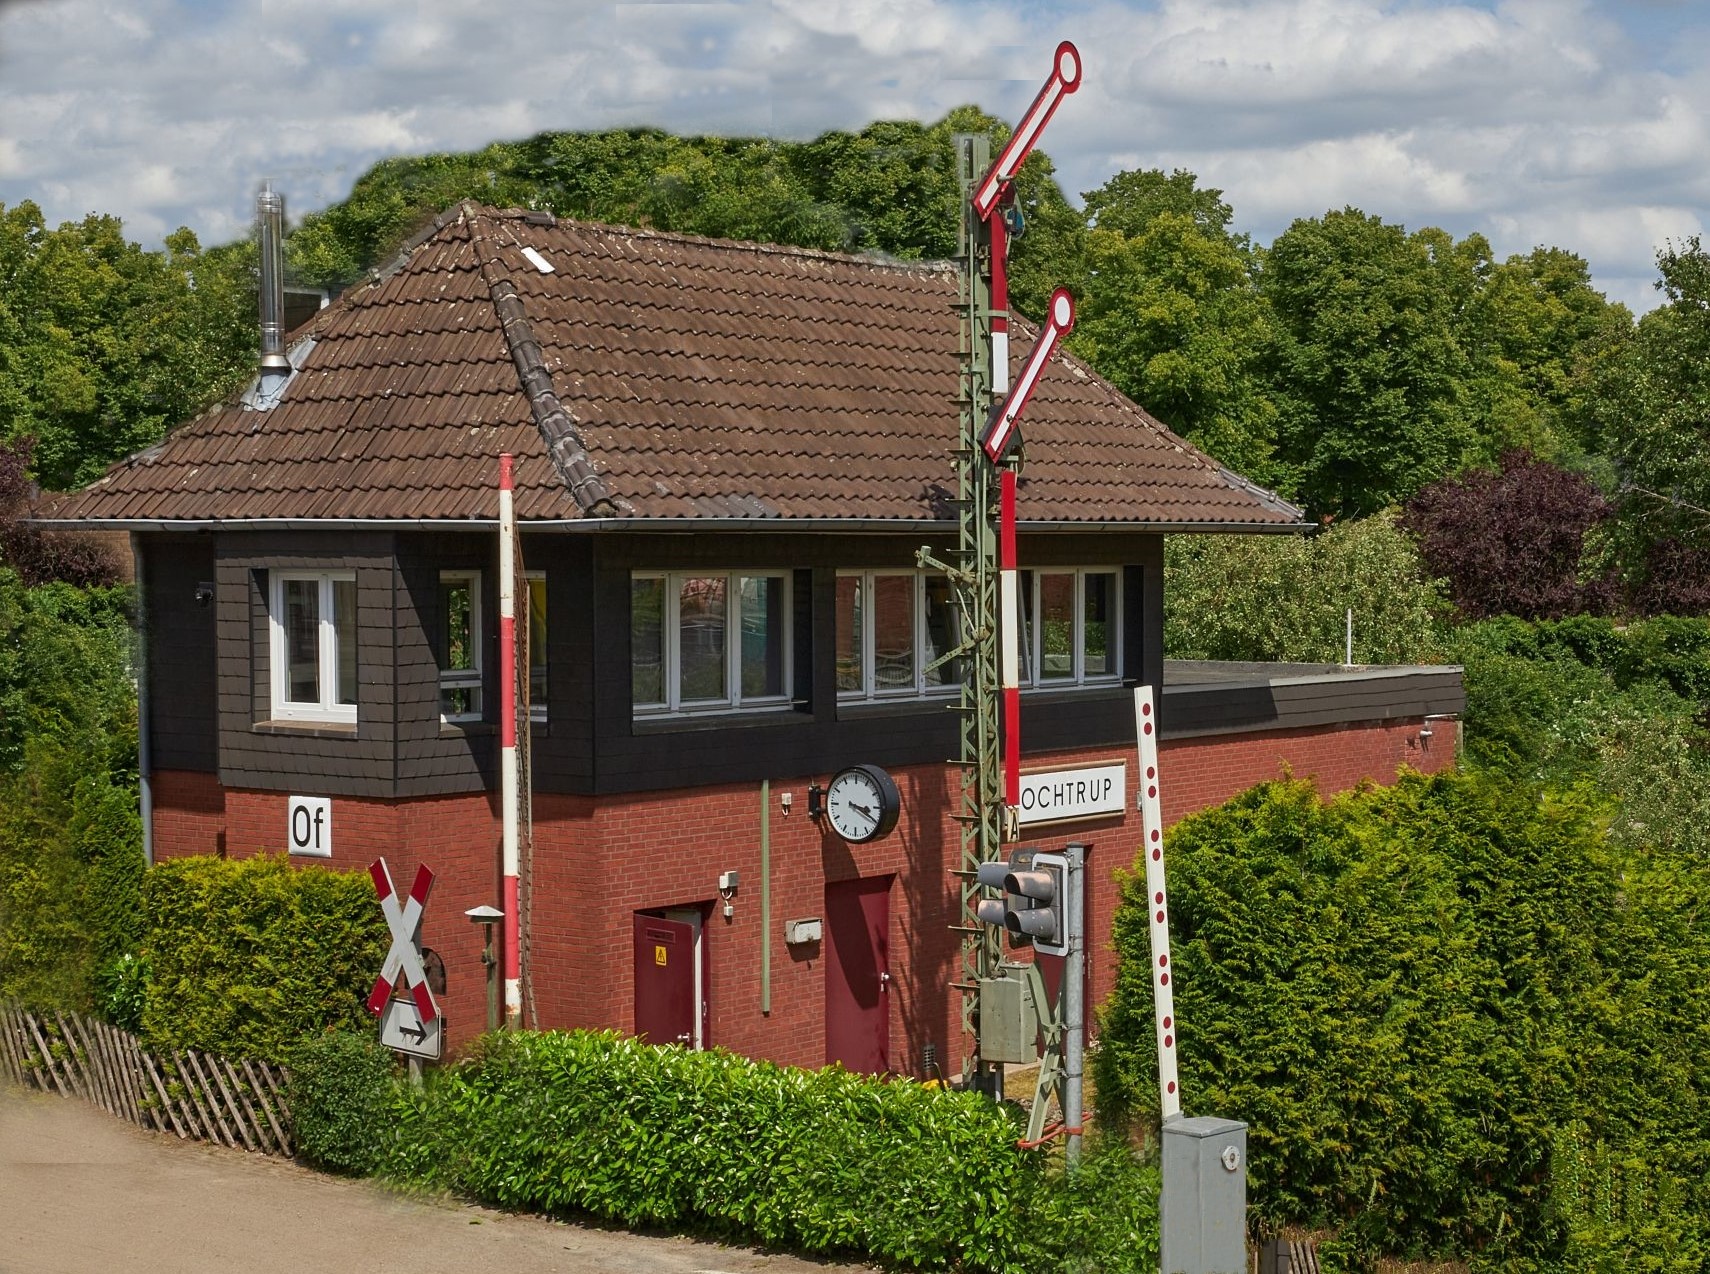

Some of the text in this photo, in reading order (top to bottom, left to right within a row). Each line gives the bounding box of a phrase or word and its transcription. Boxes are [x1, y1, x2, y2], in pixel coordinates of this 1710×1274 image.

[1021, 778, 1112, 811] OCHTRUP
[292, 804, 324, 849] Of
[1010, 811, 1019, 840] A
